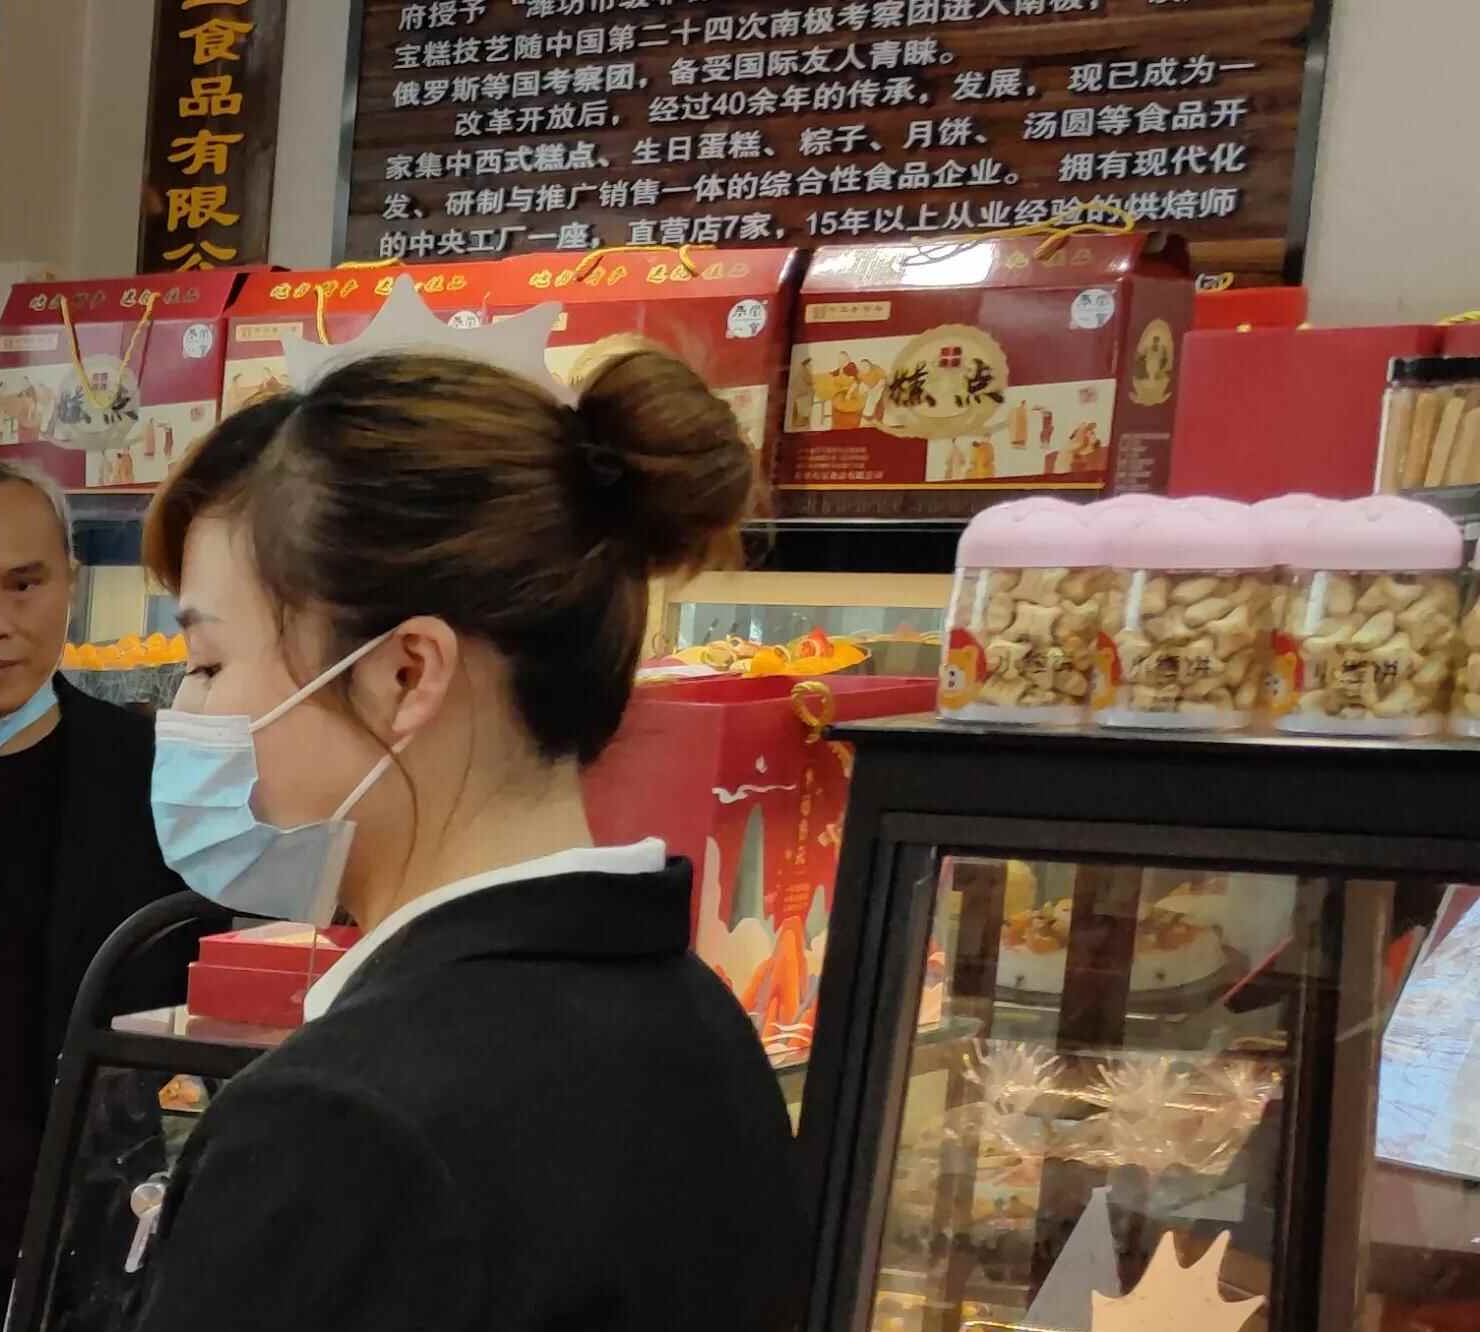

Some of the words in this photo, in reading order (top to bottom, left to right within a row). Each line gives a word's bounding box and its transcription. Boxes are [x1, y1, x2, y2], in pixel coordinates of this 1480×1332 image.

[163, 0, 254, 272] 食品有限公
